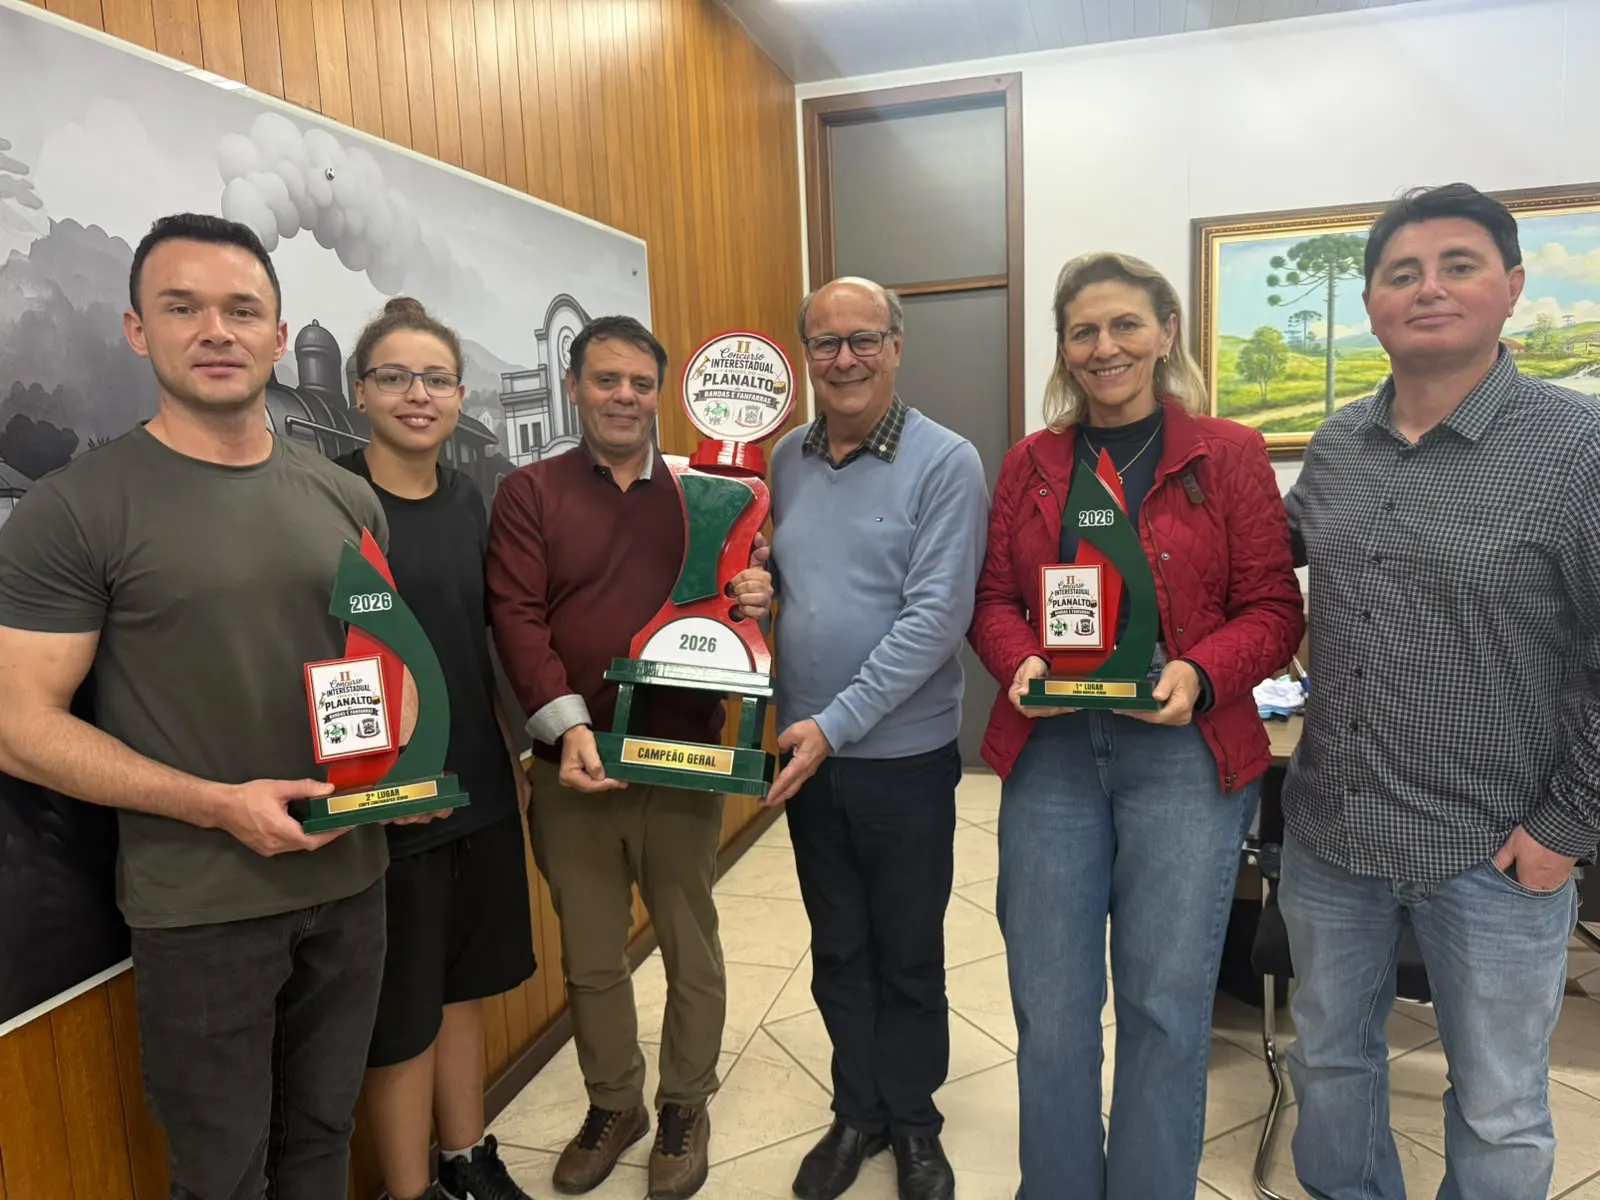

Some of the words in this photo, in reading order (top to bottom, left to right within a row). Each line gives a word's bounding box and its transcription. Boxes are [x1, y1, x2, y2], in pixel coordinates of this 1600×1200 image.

[736, 340, 752, 353] II
[720, 347, 766, 361] Concurso
[711, 358, 774, 374] INTERESTADUAL
[702, 373, 774, 392] PLANALTO
[704, 390, 730, 398] BANDAS
[736, 392, 772, 404] FANFARRAS
[1078, 509, 1114, 527] 2026
[1066, 575, 1076, 584] II
[1054, 588, 1090, 596] INTERESTADUAL
[350, 591, 392, 613] 2026
[1052, 598, 1091, 609] PLANALTO
[679, 634, 717, 653] 2026
[339, 671, 351, 681] II
[329, 678, 363, 689] Concurso
[326, 684, 371, 698] INTERESTADUAL
[325, 696, 373, 712] PLANALTO
[637, 747, 685, 764] CAMPEÃO
[687, 752, 716, 767] GERAL
[377, 788, 400, 799] LUGAR
